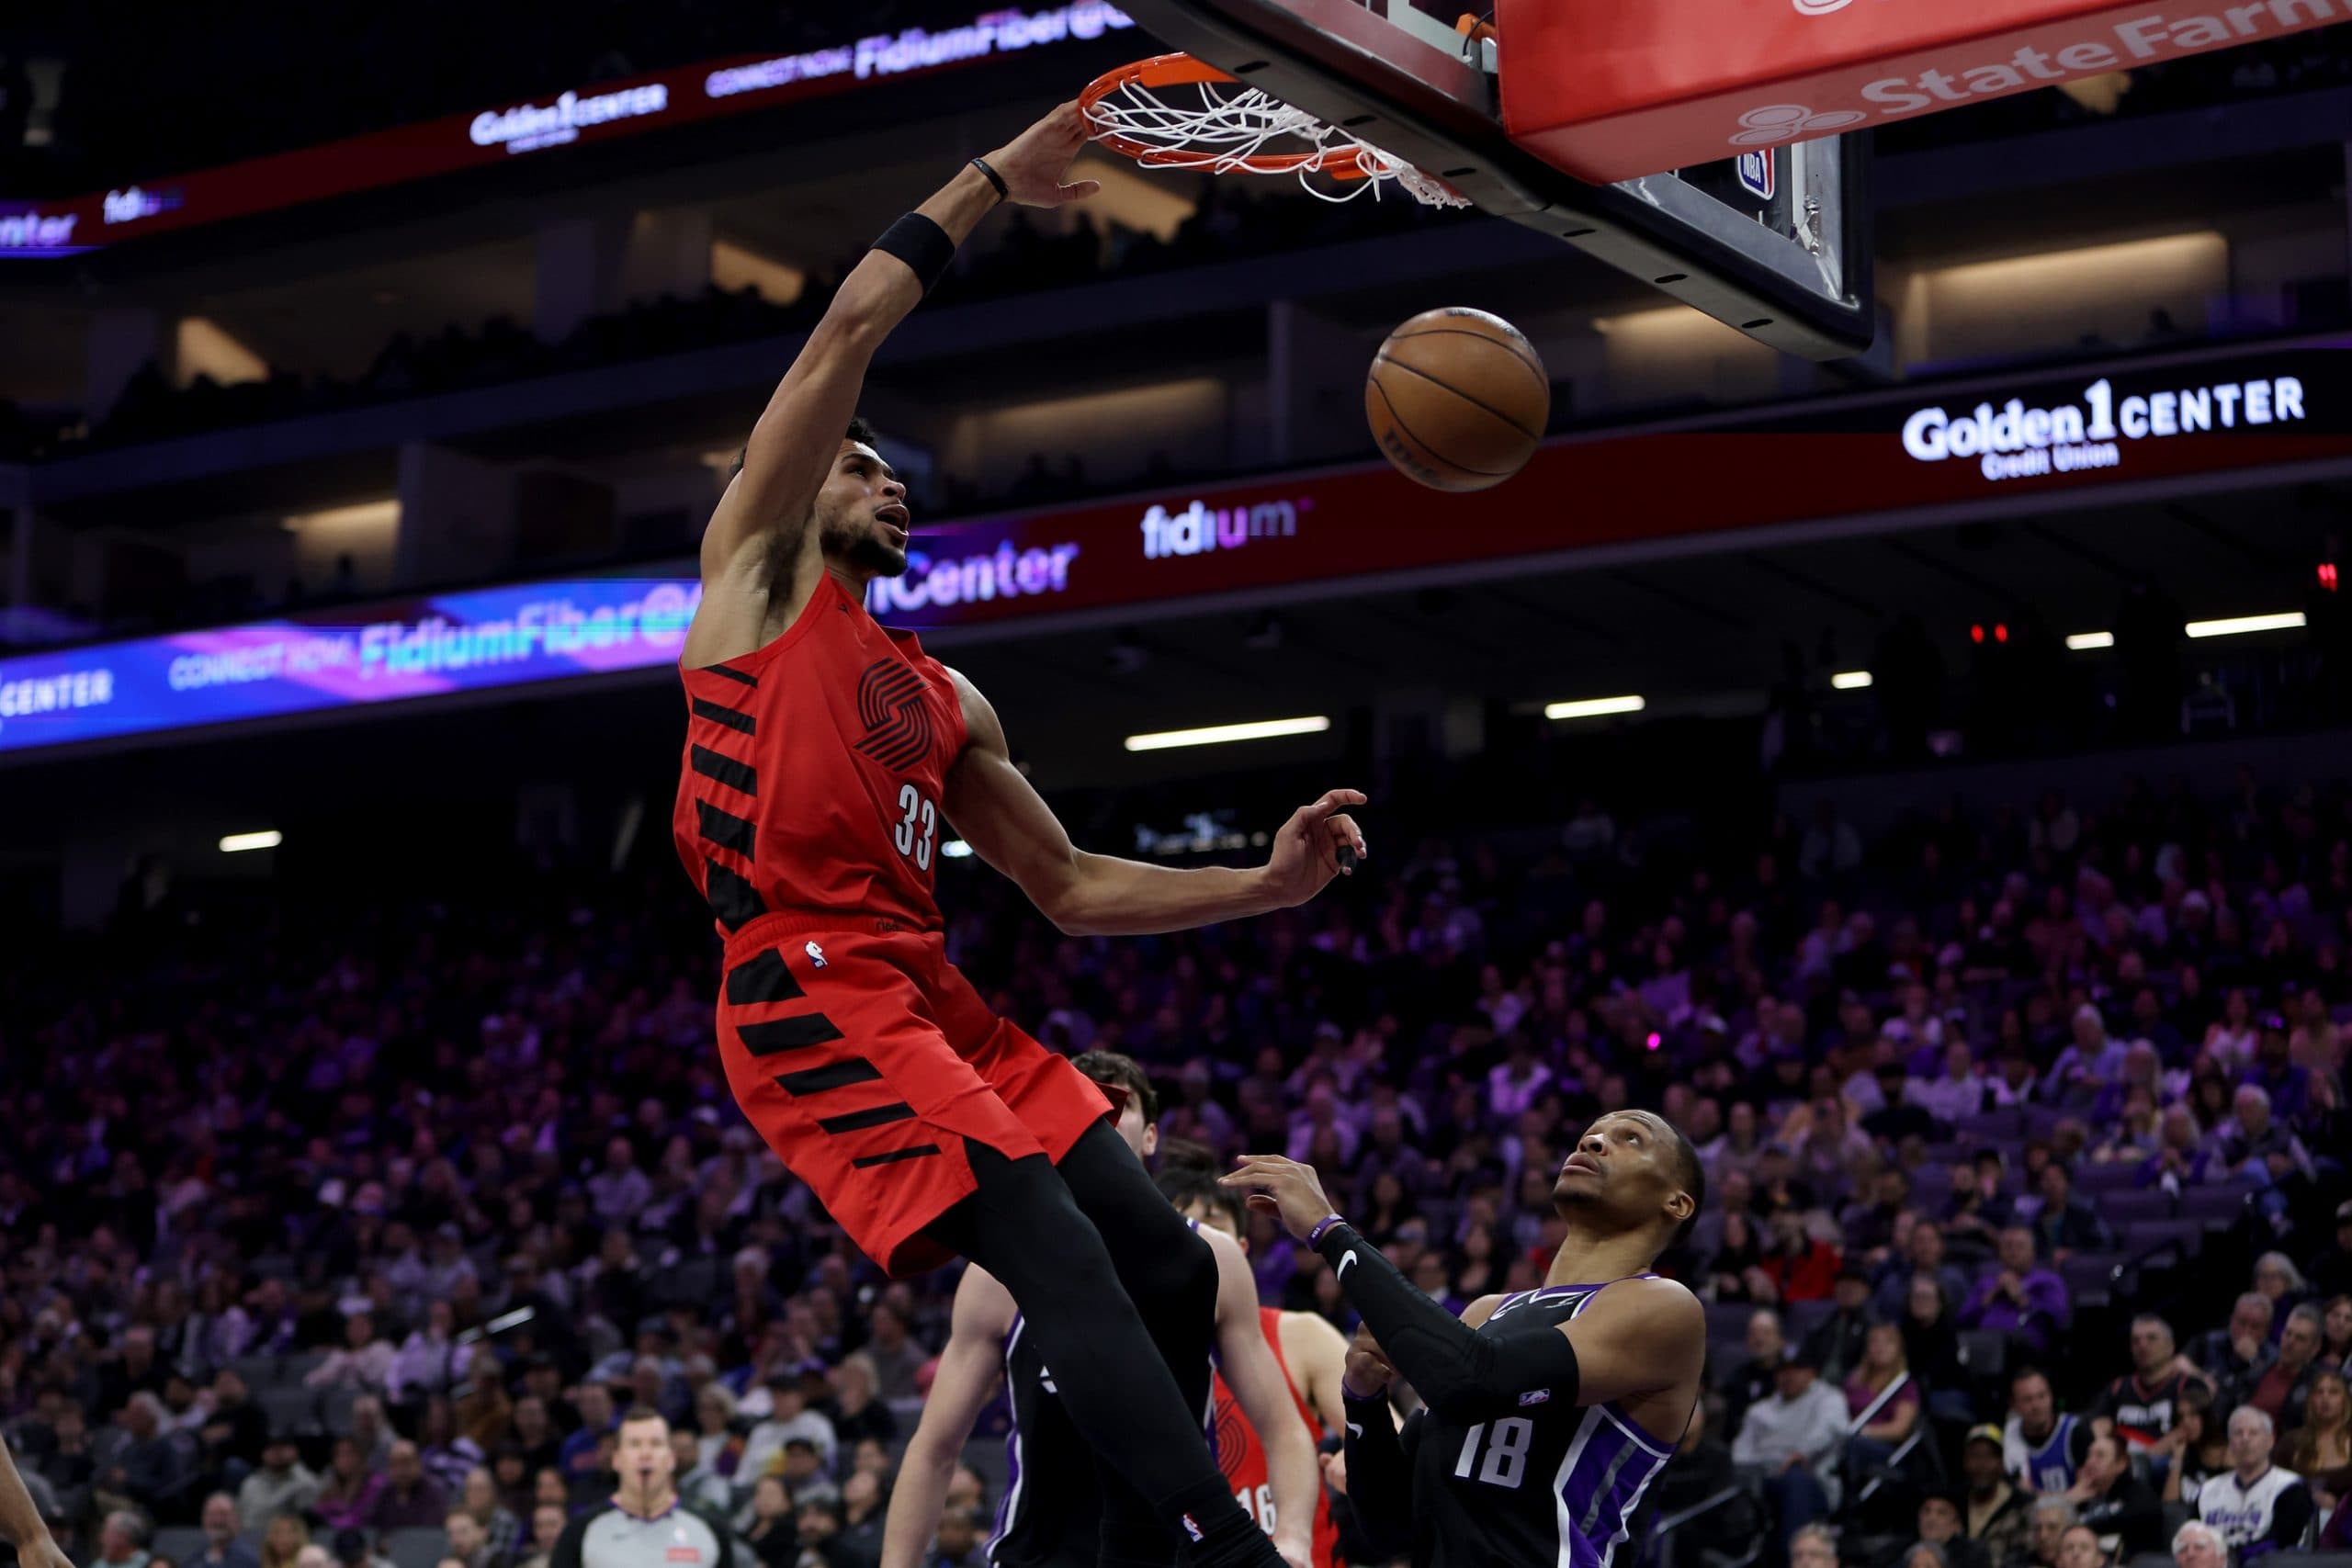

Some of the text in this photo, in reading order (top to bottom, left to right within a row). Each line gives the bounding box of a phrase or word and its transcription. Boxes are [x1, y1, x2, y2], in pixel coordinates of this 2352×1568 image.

[1743, 152, 1762, 184] NBA
[2119, 377, 2305, 439] CENTER
[1141, 500, 1297, 559] fidium
[0, 669, 114, 717] CENTER
[894, 784, 936, 872] 33
[1454, 1416, 1533, 1489] 18
[1235, 1484, 1278, 1535] 16
